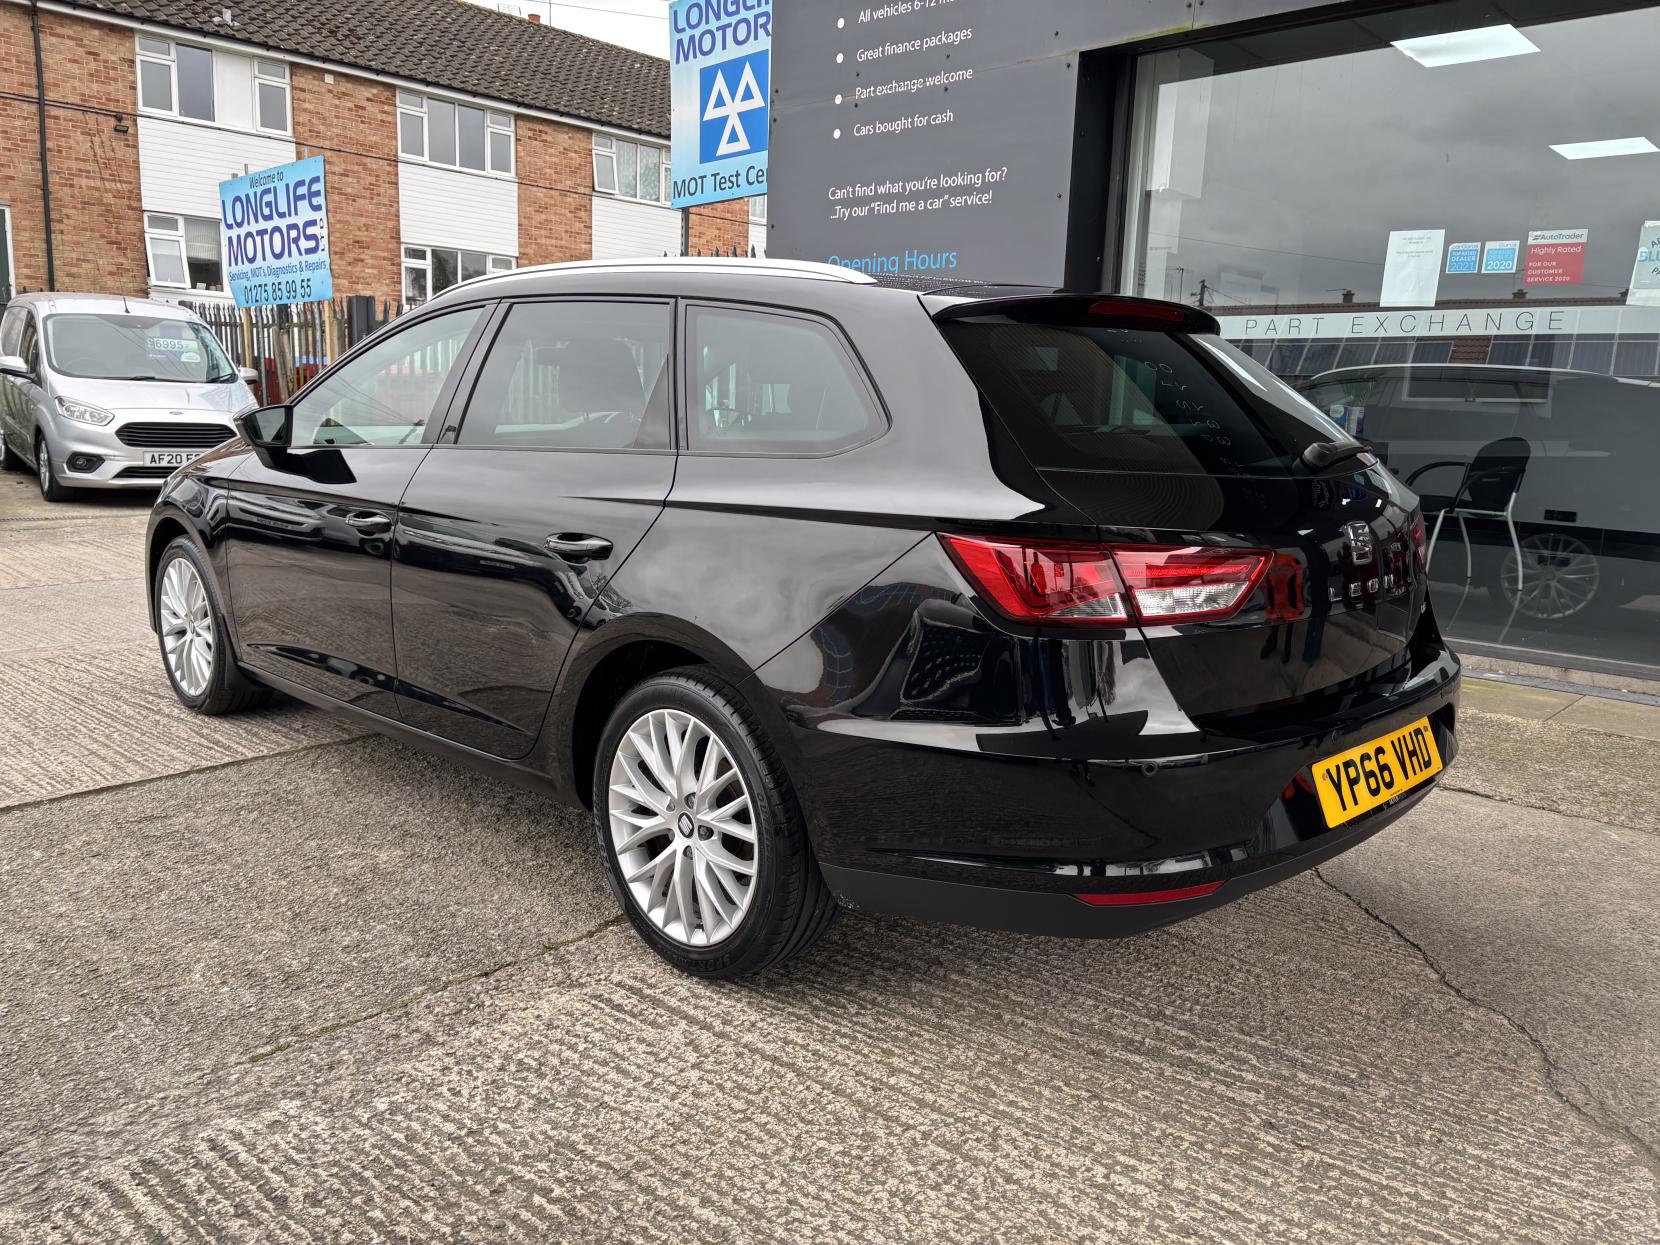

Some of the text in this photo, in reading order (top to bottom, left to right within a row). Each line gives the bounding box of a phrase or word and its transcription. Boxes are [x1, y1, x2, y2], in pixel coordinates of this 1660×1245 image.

[858, 9, 871, 23] All
[872, 2, 912, 20] vehicles
[856, 28, 972, 62] Great finance packages
[855, 68, 973, 99] Part exchange welcome
[853, 109, 954, 136] Cars bought for cash
[249, 170, 284, 190] Welcome to
[673, 165, 768, 199] MOT Test Ce
[855, 182, 875, 197] find
[877, 178, 903, 194] what
[940, 171, 982, 187] looking
[984, 167, 1008, 183] for?
[221, 175, 323, 230] LONGLIFE
[851, 207, 869, 217] our
[899, 202, 916, 212] me
[918, 200, 925, 210] a
[949, 190, 993, 207] service!
[227, 218, 320, 268] MOTORS
[1540, 232, 1585, 241] AutoTrader
[827, 249, 957, 274] Opening Hours
[1531, 245, 1582, 256] Highly Rated
[229, 270, 250, 283] Servicing,
[267, 261, 299, 279] Diagnostics
[298, 261, 304, 273] &
[304, 259, 327, 273] Repairs
[1487, 260, 1512, 270] 2020
[243, 278, 313, 304] 01275 85 99 55
[1245, 311, 1565, 336] PART EXCHANGE
[150, 453, 182, 464] AF20
[1325, 728, 1432, 812] YP66 VHD
